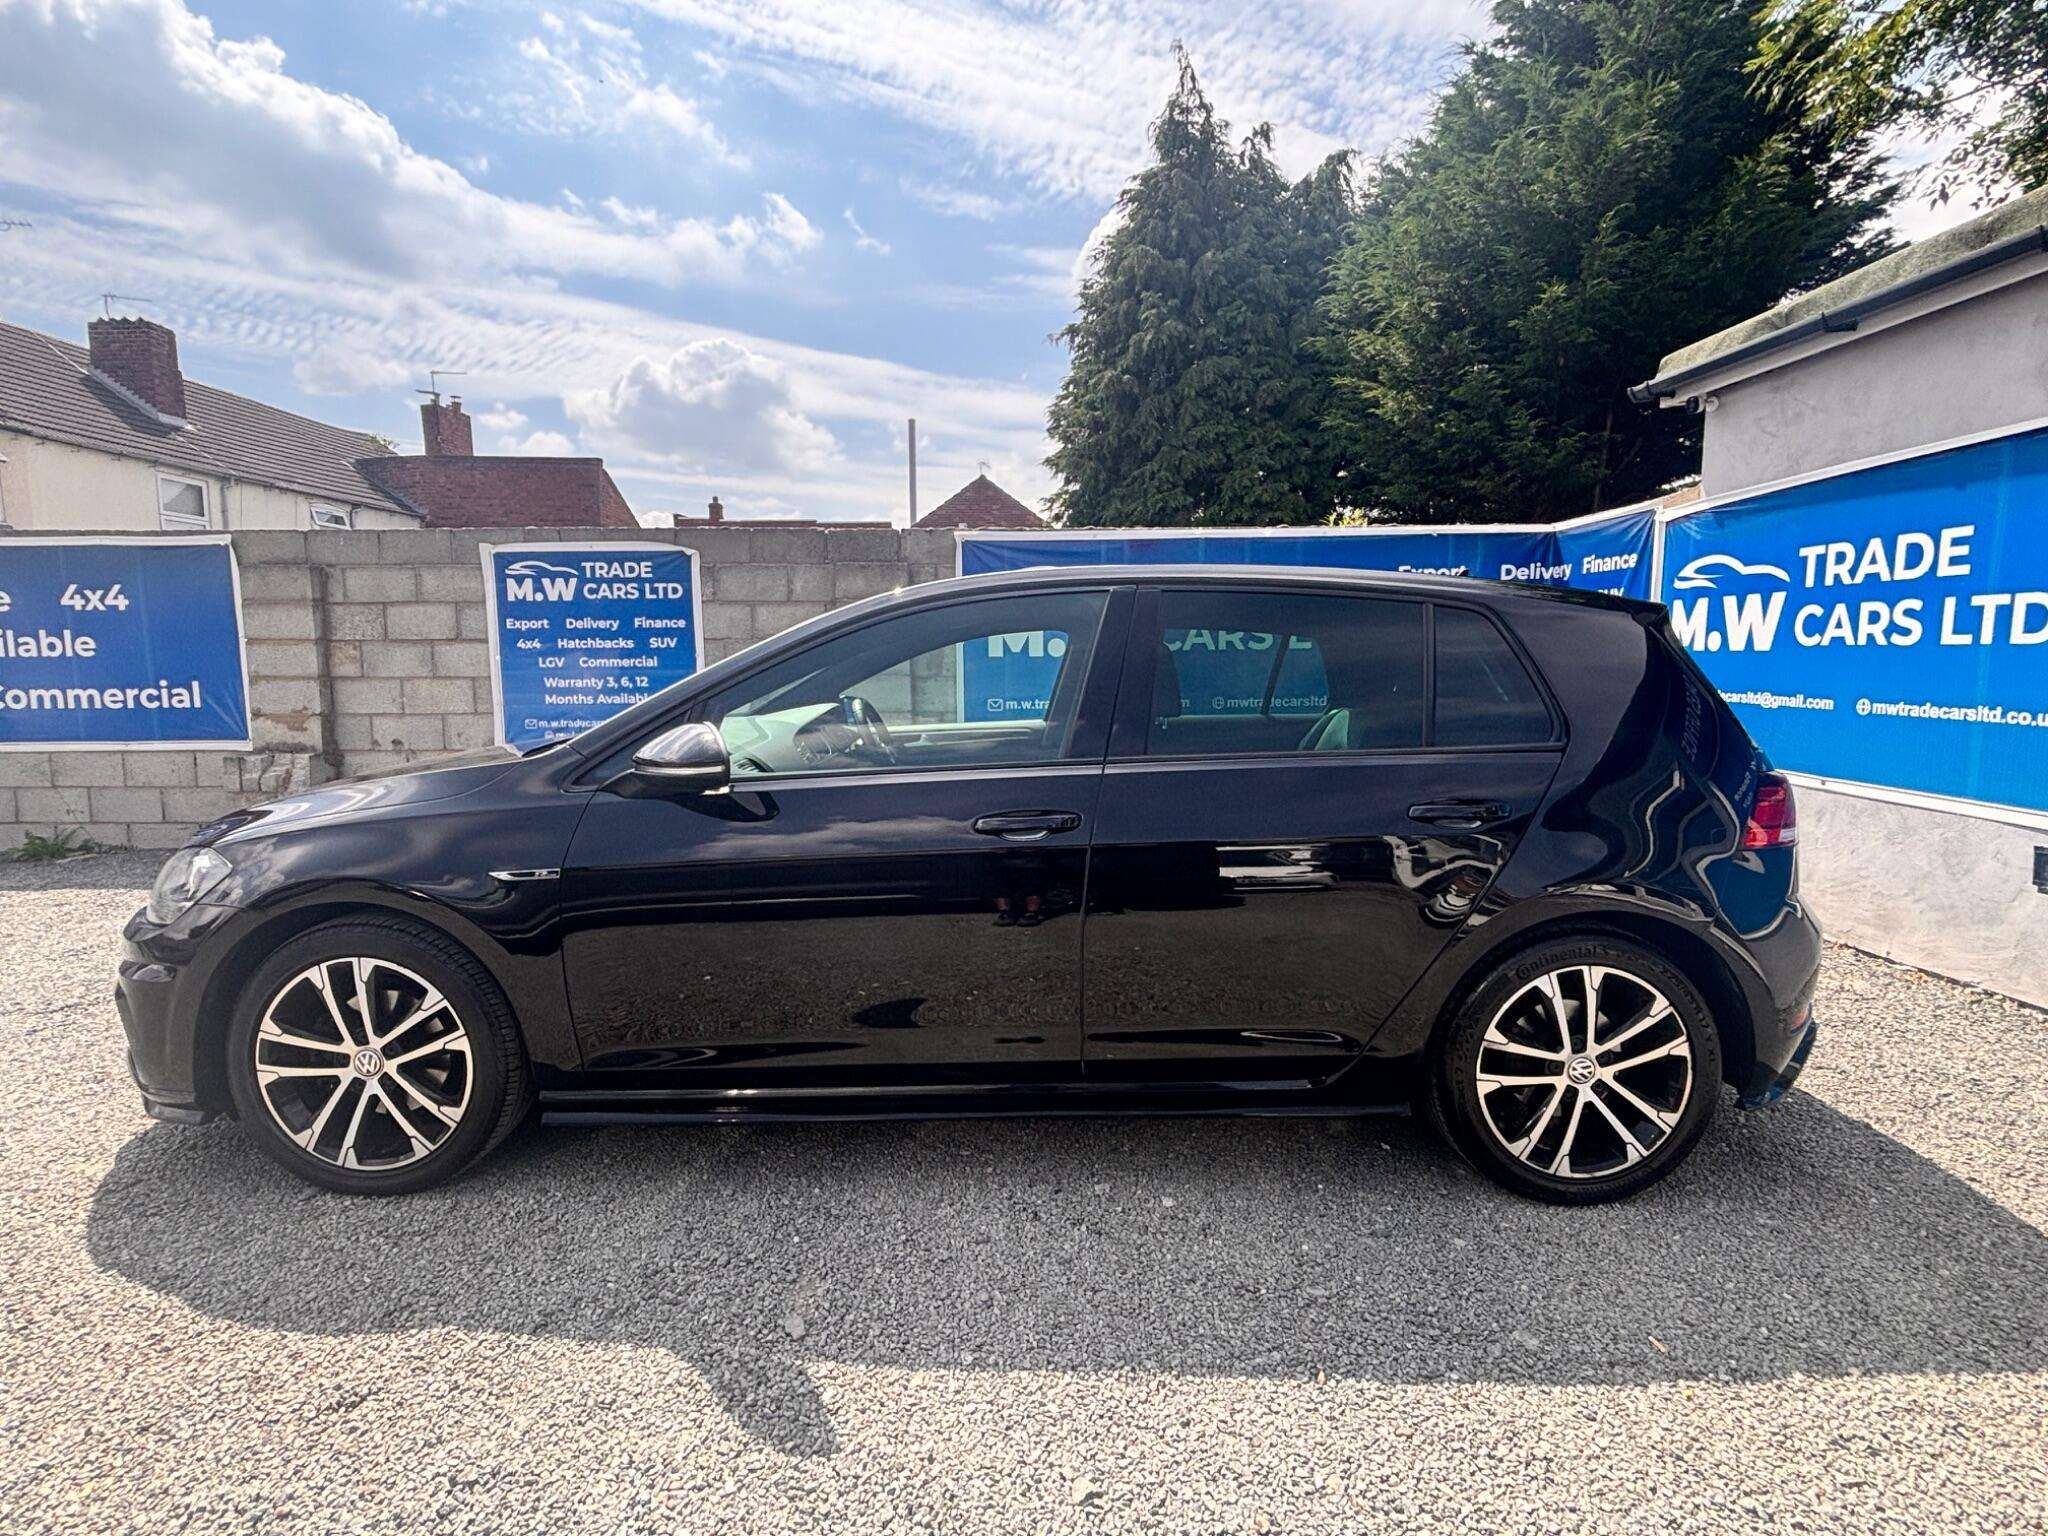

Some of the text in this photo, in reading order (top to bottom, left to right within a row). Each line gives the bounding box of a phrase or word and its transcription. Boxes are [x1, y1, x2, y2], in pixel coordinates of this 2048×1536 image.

[1500, 551, 1638, 581] Delivery Finance
[1799, 525, 1975, 588] TRADE
[581, 562, 653, 578] TRADE
[60, 583, 130, 611] 4x4
[506, 577, 683, 601] M.W CARS LTD
[506, 617, 686, 631] Export Delivery Finance
[1671, 591, 2048, 652] M.W CARS LTD
[516, 637, 678, 649] 4x4 Hatchbacks SUV
[538, 656, 659, 668] LGV Commercial
[543, 677, 649, 690] Warranty 3, 6, 12
[0, 680, 202, 710] ommercial
[545, 695, 594, 705] Months
